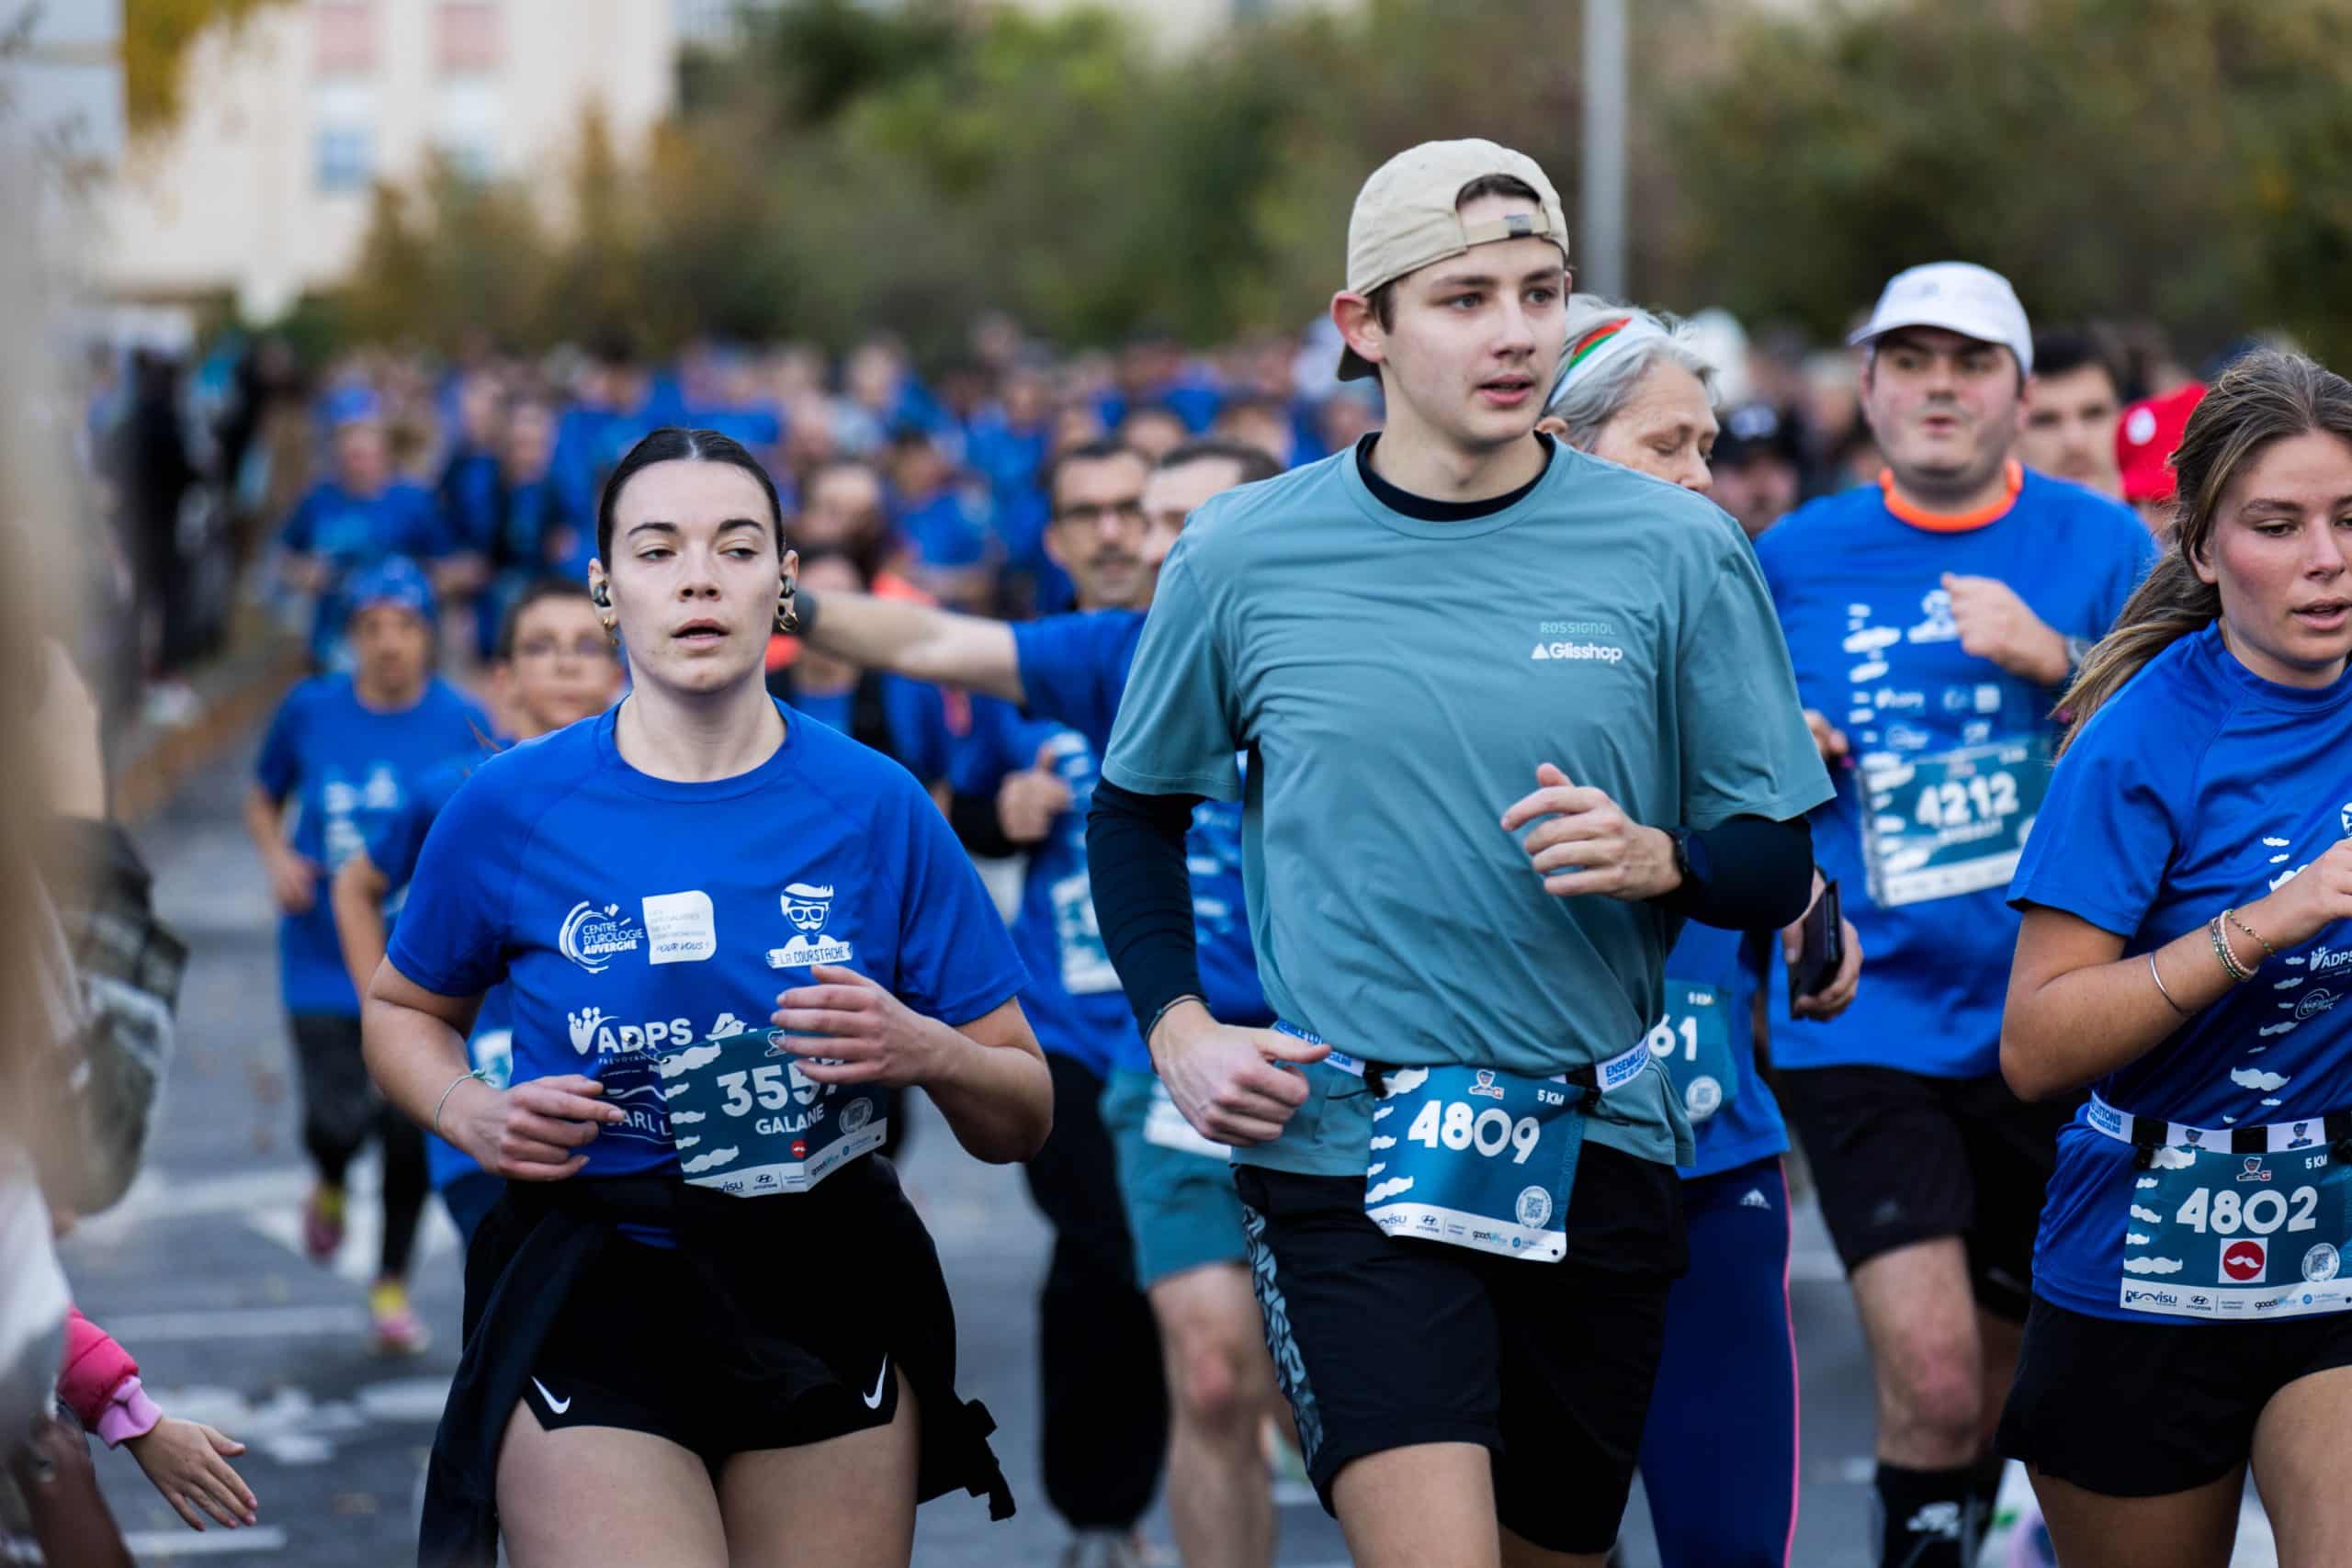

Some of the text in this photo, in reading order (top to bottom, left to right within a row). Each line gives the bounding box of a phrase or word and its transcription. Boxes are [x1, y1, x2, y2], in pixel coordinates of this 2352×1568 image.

[1549, 641, 1623, 664] Glisshop
[1916, 771, 2019, 829] 4212
[582, 921, 617, 936] CENTRE
[583, 928, 643, 946] D'UROLOGIE
[582, 940, 638, 955] AUVERGNE
[597, 1018, 693, 1054] ADPS
[1537, 1089, 1565, 1106] 5 KM
[755, 1103, 824, 1135] GALANE
[1408, 1100, 1540, 1165] 4809
[2176, 1185, 2318, 1235] 4802
